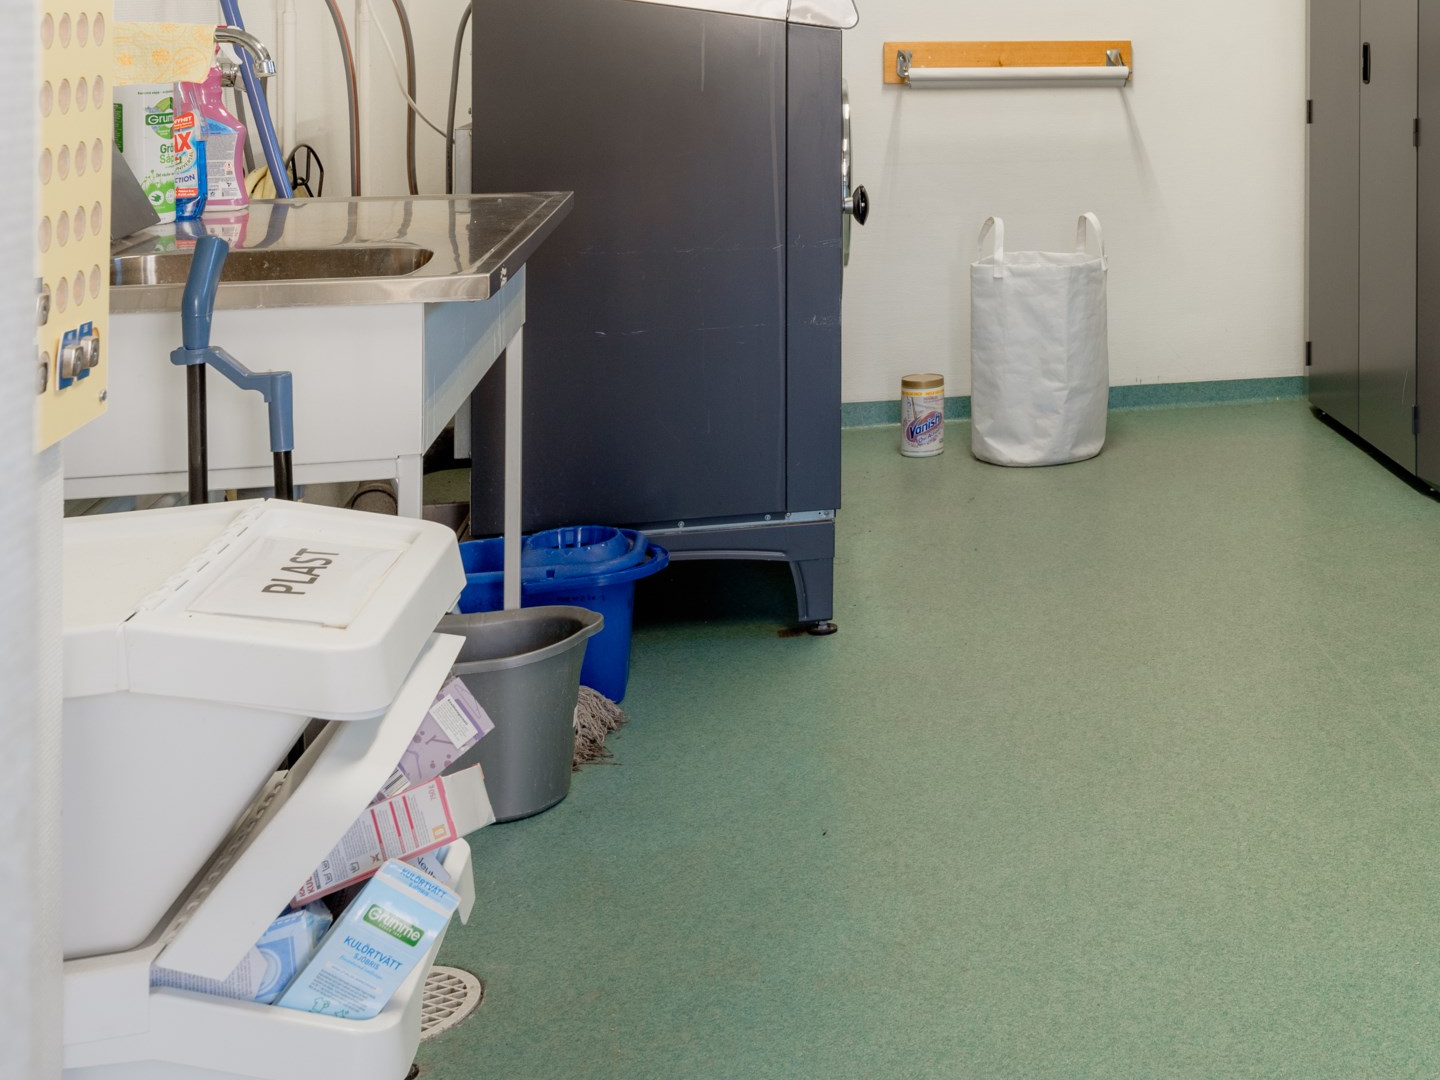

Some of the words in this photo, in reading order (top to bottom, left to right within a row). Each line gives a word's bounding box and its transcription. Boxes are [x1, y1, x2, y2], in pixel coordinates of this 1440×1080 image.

[148, 115, 174, 124] Grum
[910, 412, 940, 439] Vanish
[261, 547, 340, 595] PLAST
[367, 906, 421, 941] Grumme
[343, 935, 403, 970] KULÖRTVÄTT
[352, 952, 380, 970] SJÖBRIS
